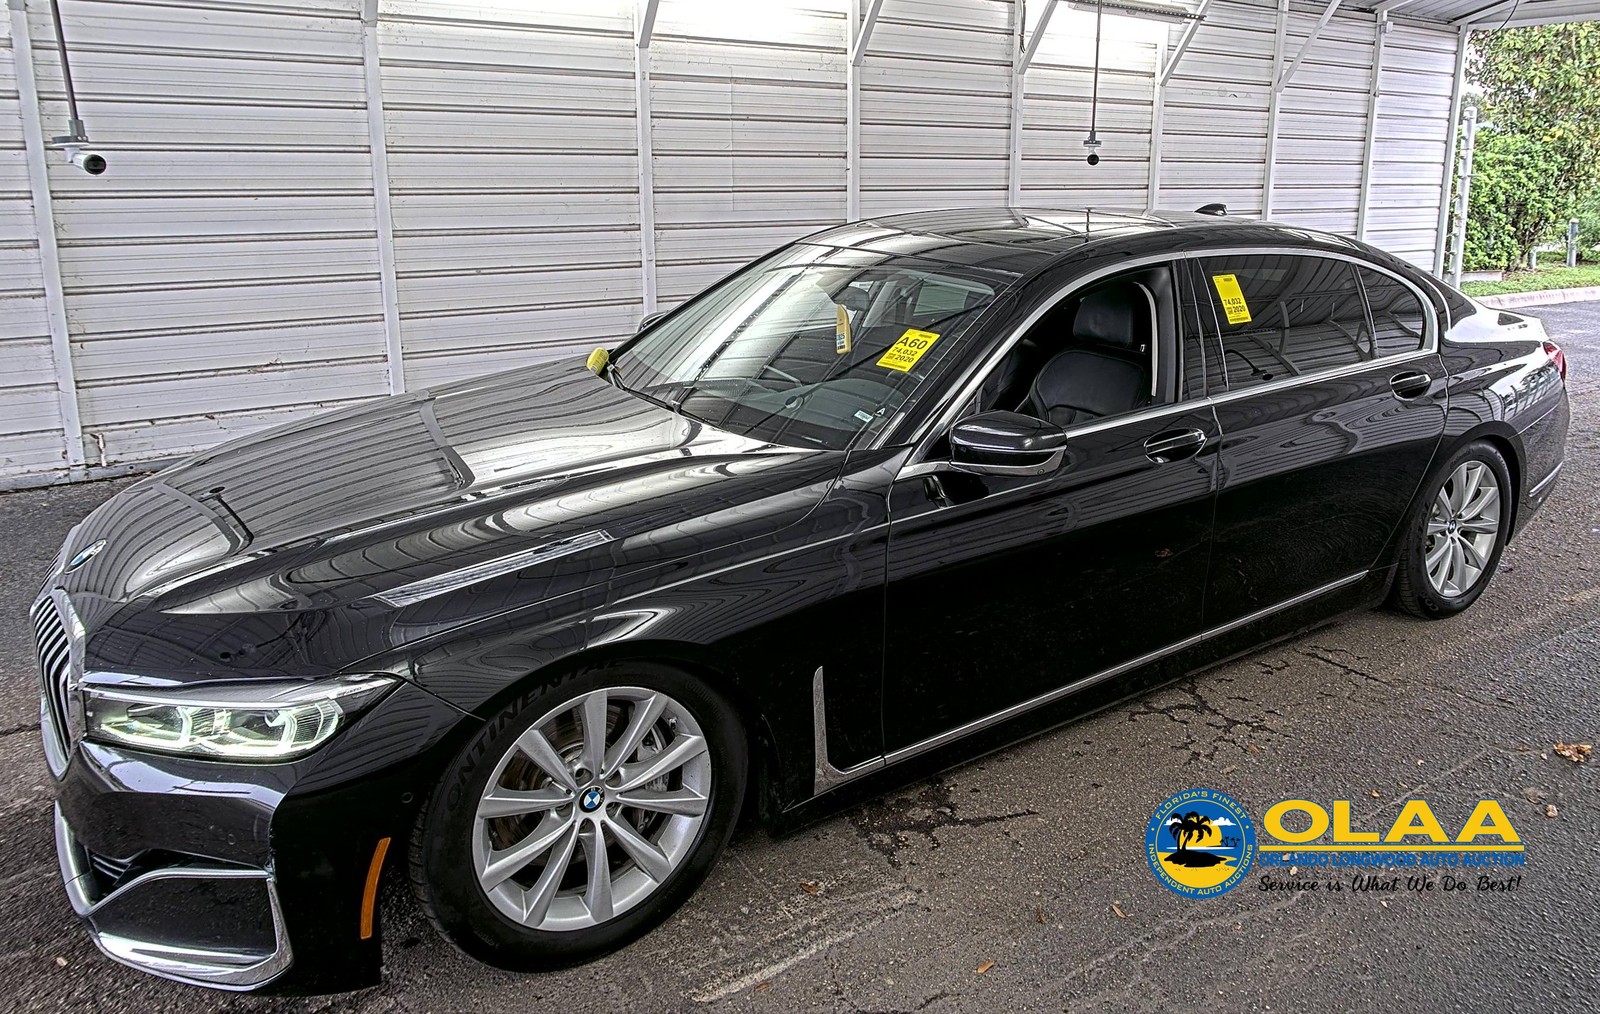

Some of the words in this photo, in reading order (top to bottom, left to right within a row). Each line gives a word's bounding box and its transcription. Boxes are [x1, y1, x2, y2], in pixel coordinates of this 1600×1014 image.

[1232, 305, 1246, 313] 2020
[896, 336, 929, 350] A60
[894, 354, 915, 363] 2020
